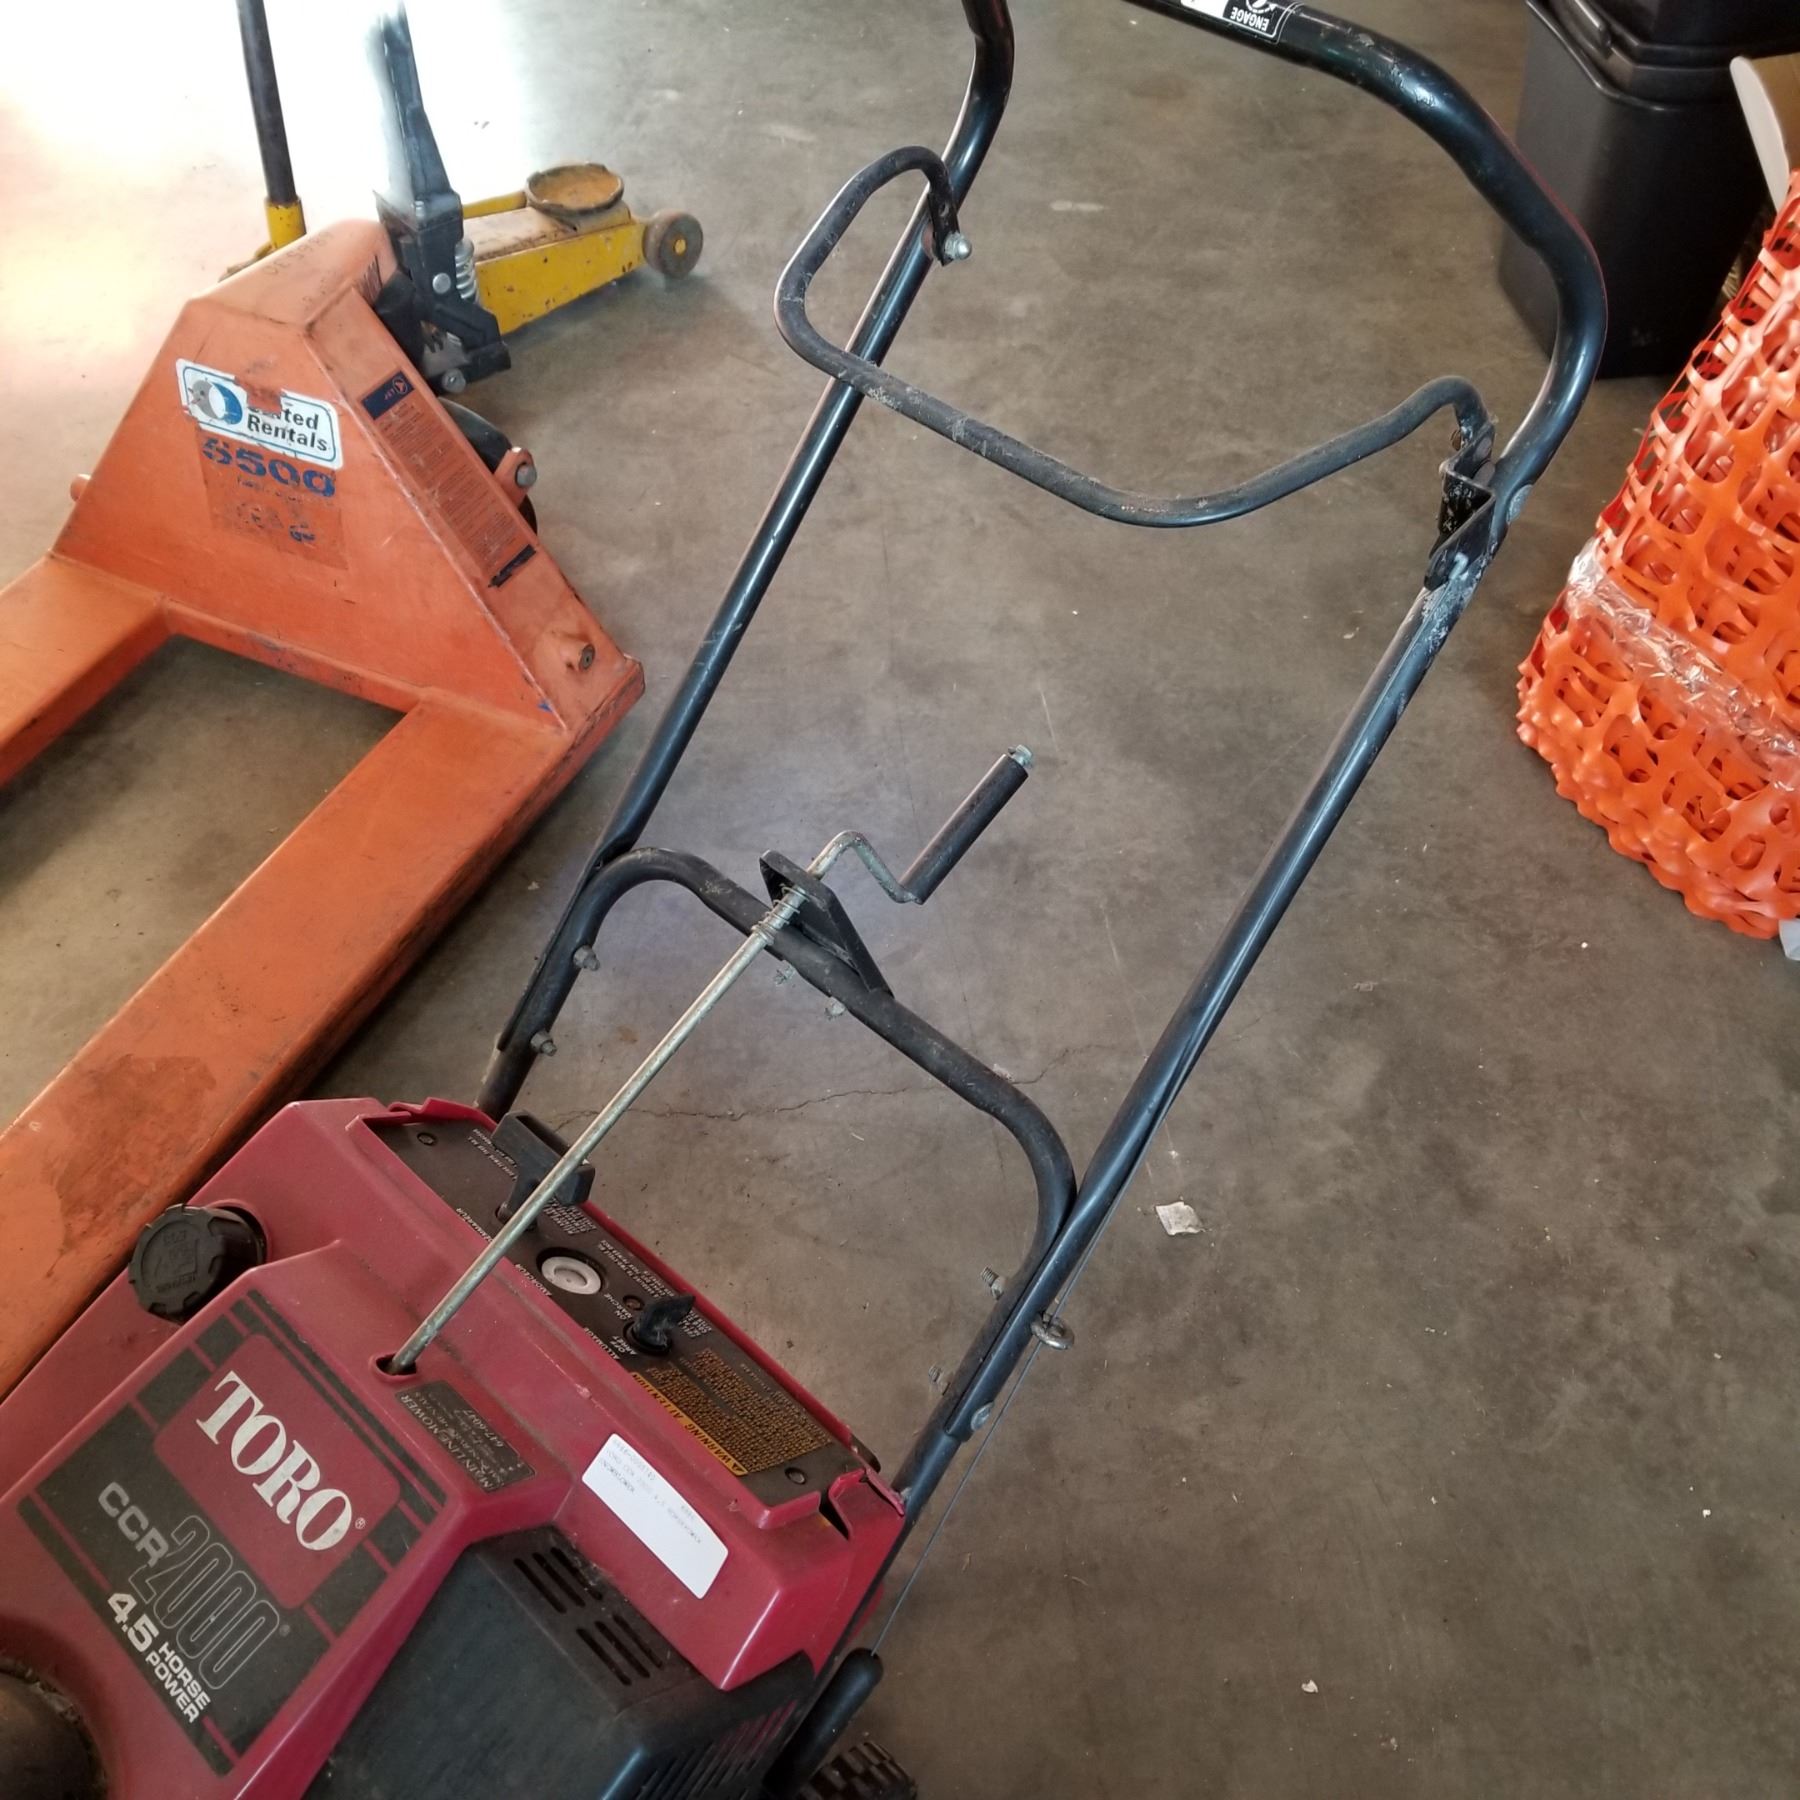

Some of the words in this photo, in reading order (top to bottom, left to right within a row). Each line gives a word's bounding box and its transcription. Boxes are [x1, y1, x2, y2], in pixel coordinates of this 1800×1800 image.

[1231, 6, 1269, 32] ENGAGE
[247, 414, 328, 452] Rentals
[604, 1293, 632, 1318] MARCHE
[614, 1310, 628, 1320] ON
[610, 1340, 625, 1353] OFF
[401, 1394, 439, 1434] MOWER
[632, 1373, 682, 1419] ATTENTION
[440, 1432, 467, 1459] LINE
[463, 1409, 503, 1447] 647-6047
[684, 1423, 733, 1465] WARNING
[196, 1371, 352, 1550] TORO
[466, 1459, 495, 1490] MAIN
[99, 1482, 168, 1567] CCR
[107, 1593, 159, 1652] 4.5
[128, 1515, 280, 1690] 2000
[145, 1651, 199, 1723] POWER
[158, 1641, 211, 1710] HORSE
